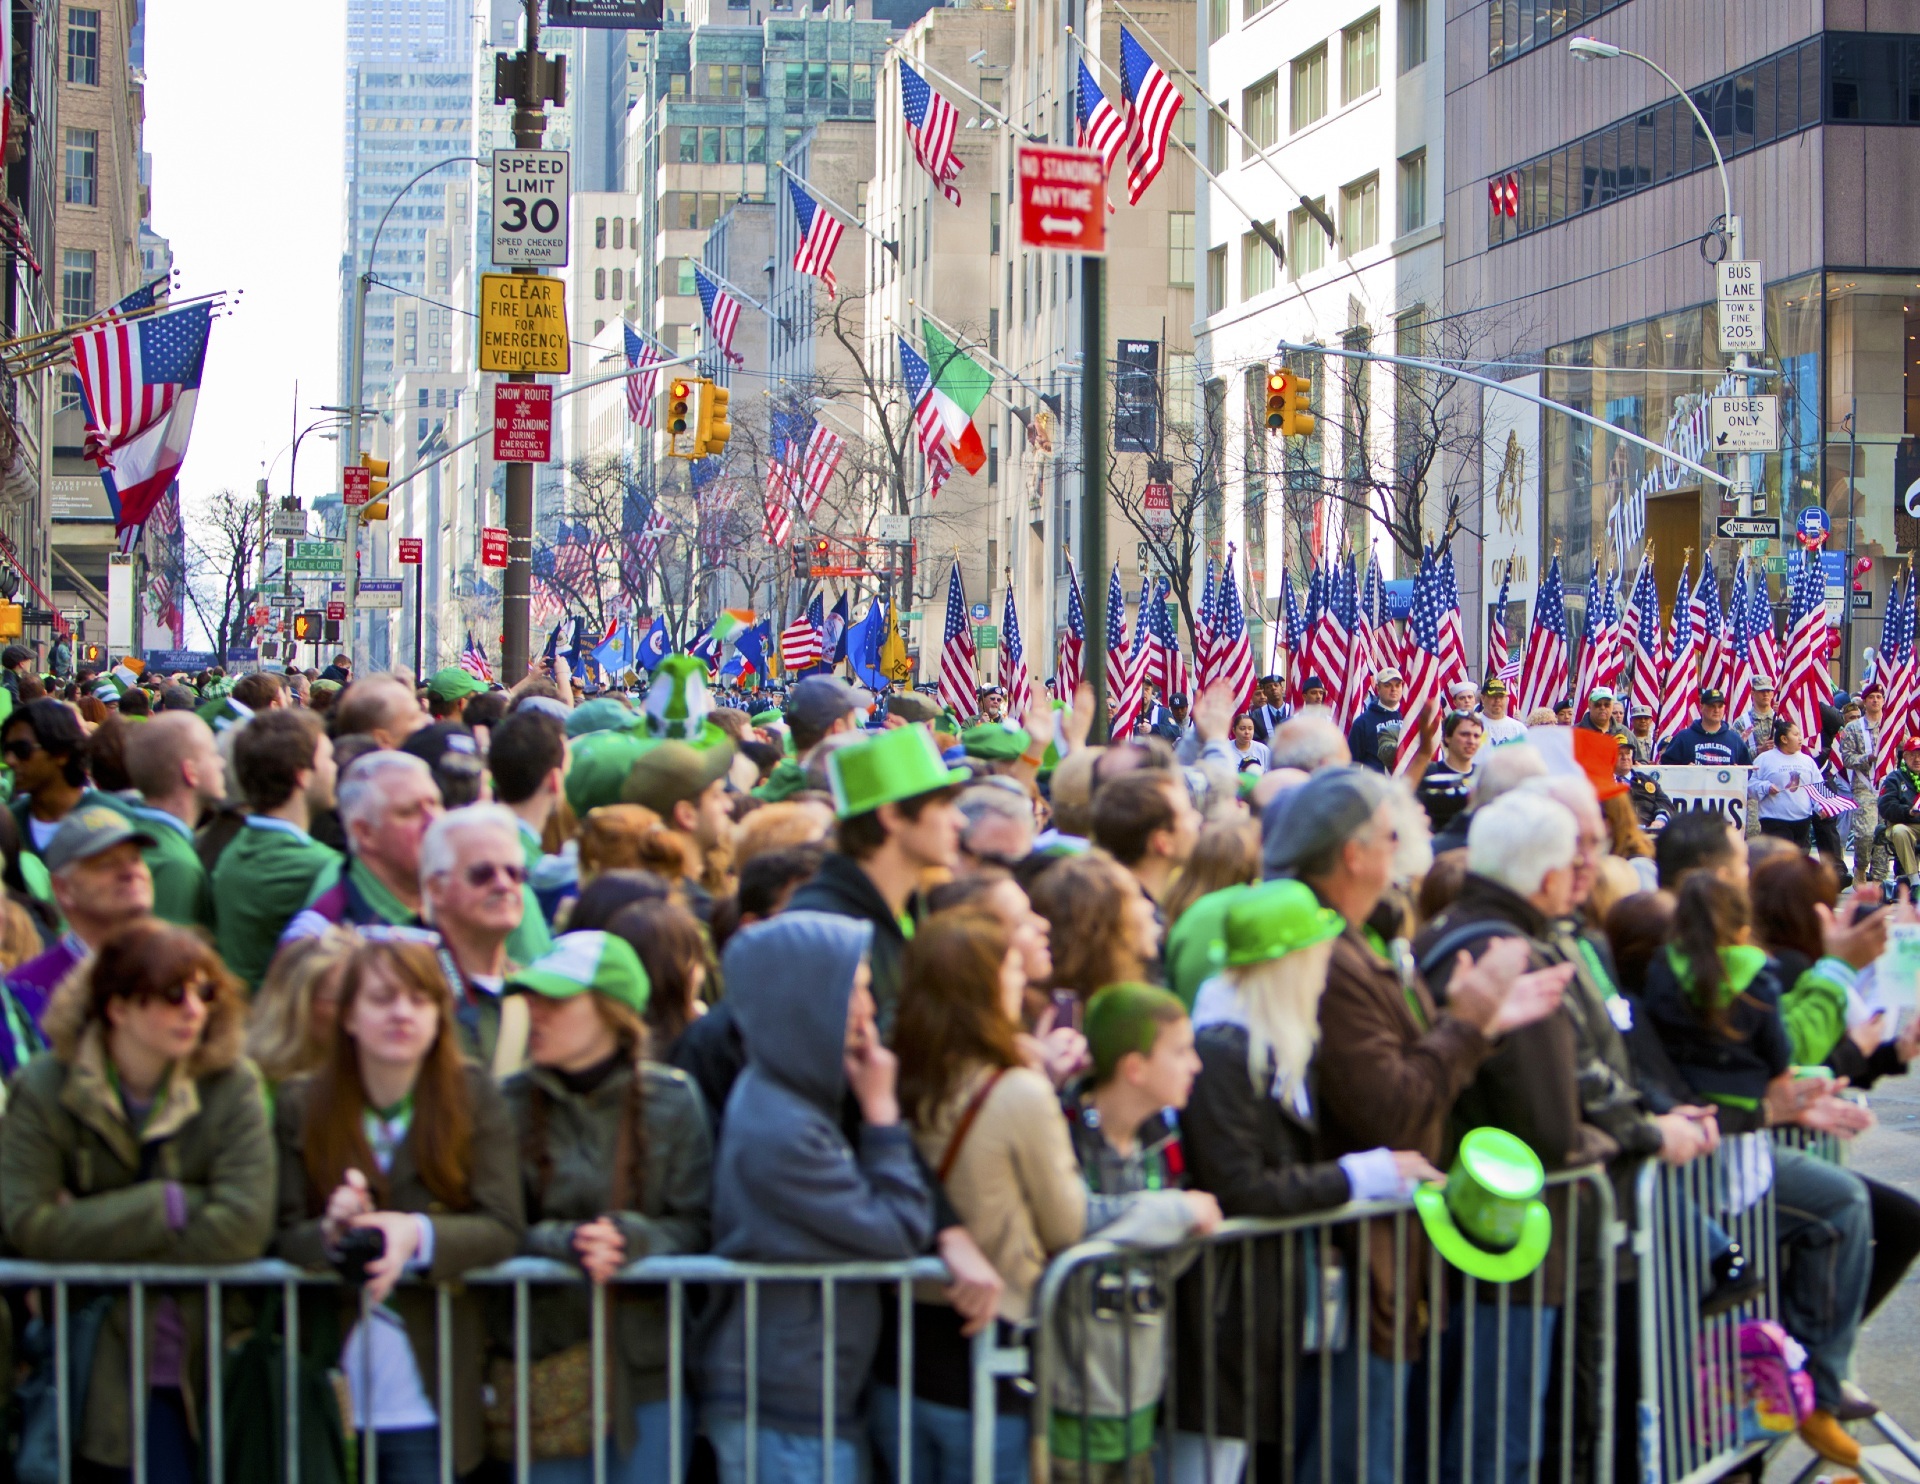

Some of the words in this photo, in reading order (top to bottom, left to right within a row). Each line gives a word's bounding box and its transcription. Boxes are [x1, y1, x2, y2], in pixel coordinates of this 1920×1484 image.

[499, 158, 564, 174] SPEED
[1022, 155, 1040, 179] NO
[1042, 157, 1100, 184] STANDING
[506, 178, 555, 193] LIMIT
[1031, 185, 1092, 212] ANYTIME
[500, 197, 560, 233] 30
[1728, 267, 1751, 278] BUS
[500, 284, 551, 300] CLEAR
[1725, 284, 1755, 296] LANE
[491, 302, 518, 317] FIRE
[526, 303, 558, 318] LANE
[515, 320, 534, 330] FOR
[1722, 326, 1753, 338] $205
[485, 331, 564, 348] EMERGENCY
[1128, 344, 1149, 353] NYC
[492, 350, 558, 366] VEHICLES
[498, 388, 519, 400] SNOW
[524, 389, 550, 401] ROUTE
[1724, 402, 1764, 412] BUSES
[497, 418, 507, 429] NO
[512, 418, 549, 431] STANDING
[1728, 416, 1759, 426] ONLY
[510, 431, 536, 439] DURING
[500, 440, 543, 449] EMERGENCY
[499, 449, 524, 457] VEHICLES
[528, 450, 545, 458] TOWED
[1151, 488, 1168, 496] RED
[1148, 498, 1169, 506] ZONE
[1726, 524, 1744, 532] ONE
[484, 531, 489, 539] NO
[490, 532, 507, 541] STANDING
[299, 544, 306, 554] E
[310, 544, 325, 555] 52
[487, 543, 504, 552] ANYTIME
[1756, 540, 1759, 554] 5
[1789, 552, 1798, 560] M1
[1768, 559, 1776, 571] W
[1783, 559, 1787, 571] 5
[1695, 743, 1731, 755] FAIRLEIGH
[1696, 752, 1730, 762] DICKINSON
